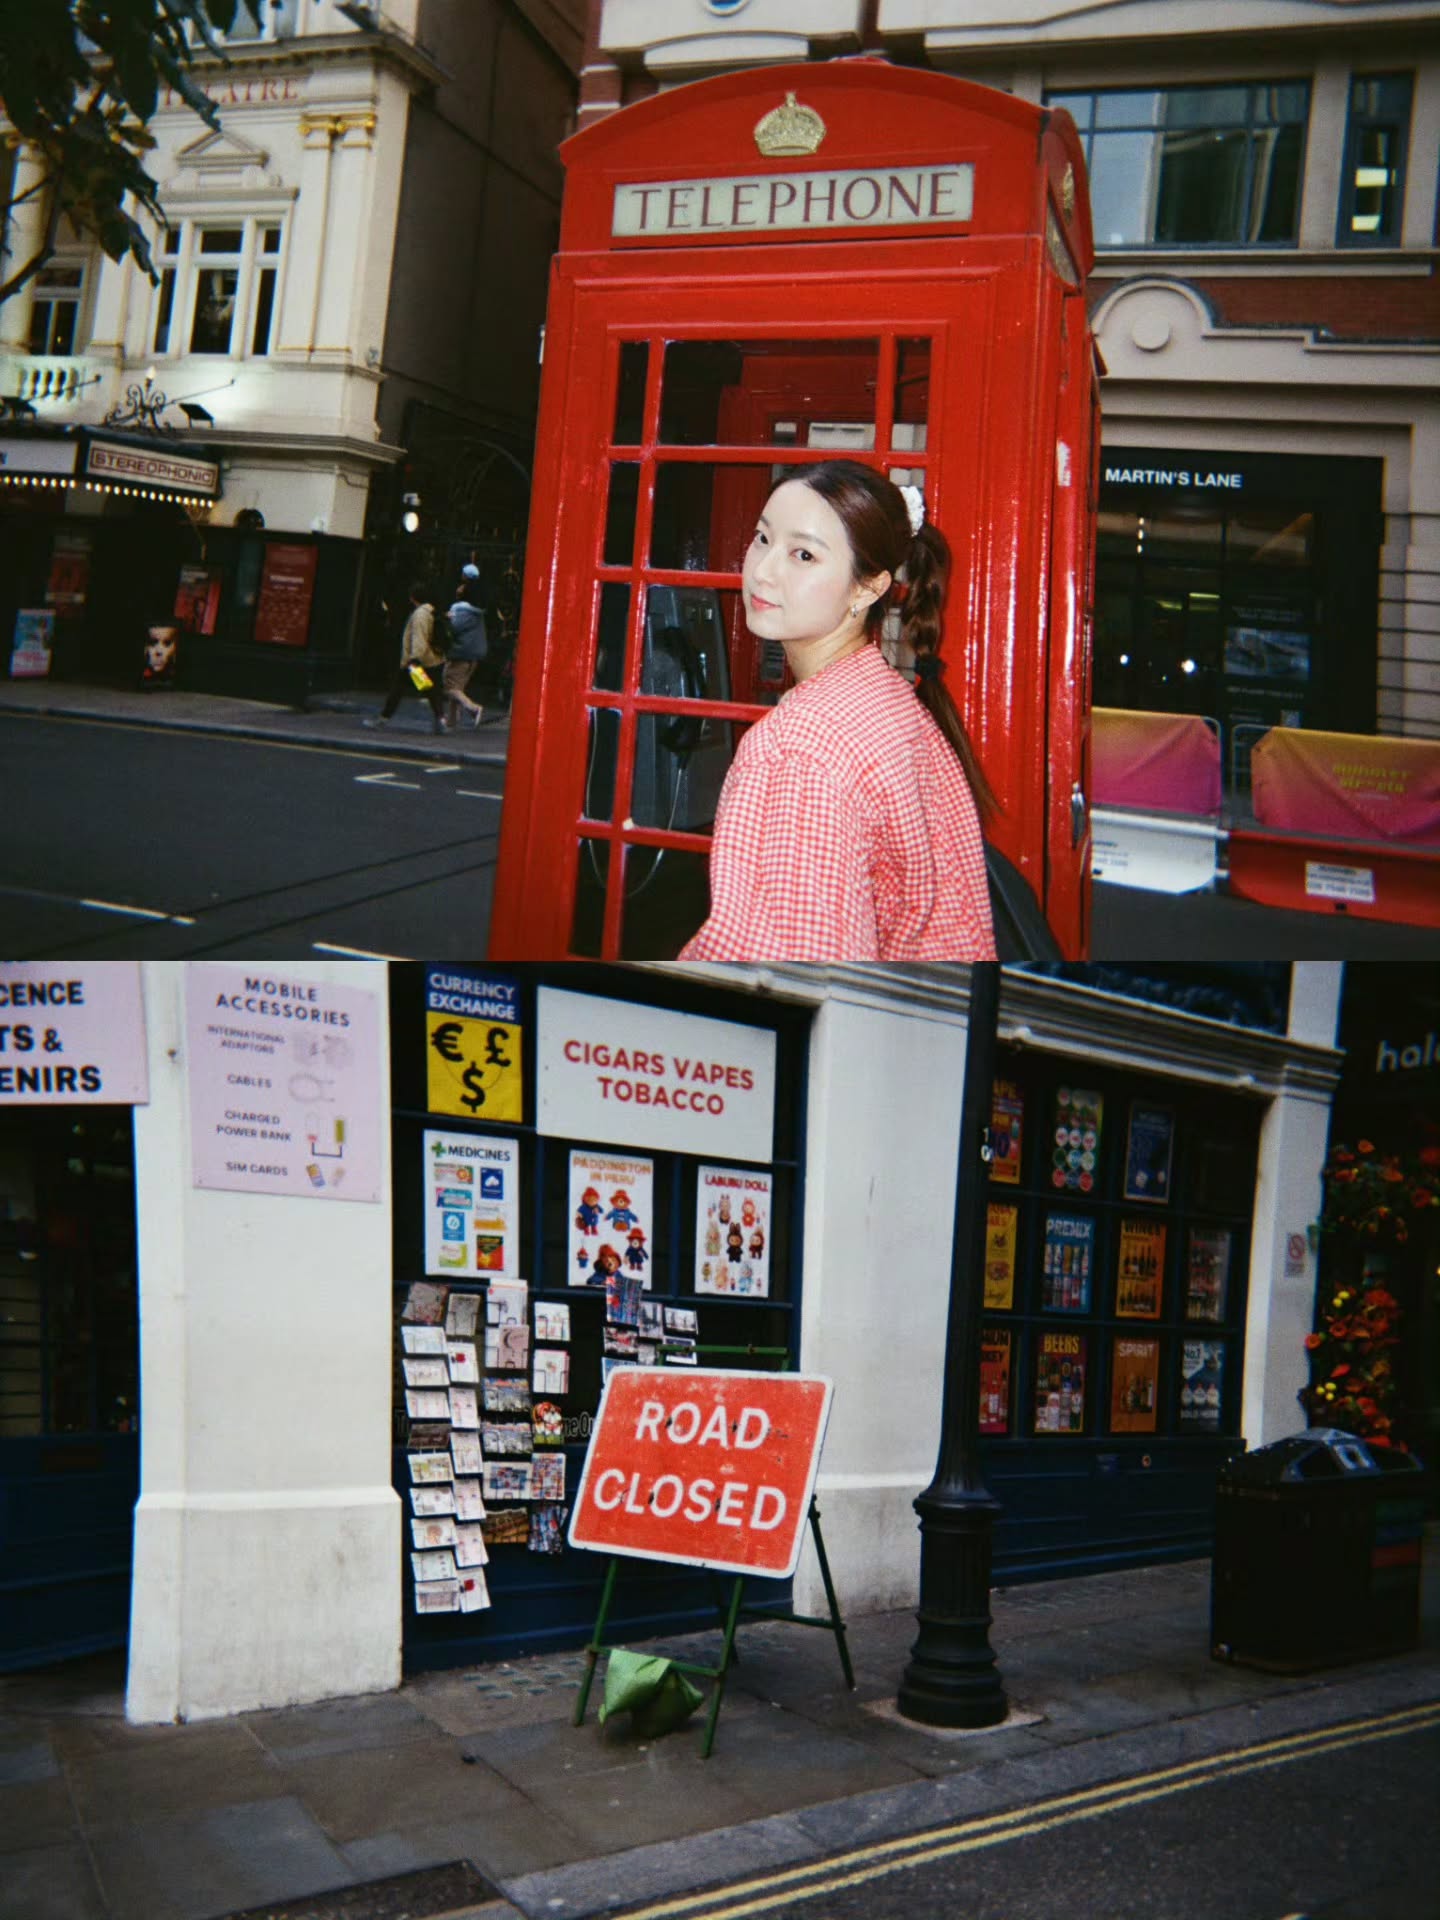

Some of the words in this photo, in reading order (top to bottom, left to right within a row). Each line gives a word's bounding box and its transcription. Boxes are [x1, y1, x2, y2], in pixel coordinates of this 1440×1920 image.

[631, 171, 959, 231] TELEPHONE
[95, 452, 212, 483] STEREOPHONIC
[1105, 468, 1190, 485] MARTIN'S
[1194, 472, 1242, 488] LANE
[245, 977, 316, 1001] MOBILE
[429, 973, 514, 1000] CURRENCY
[215, 994, 350, 1027] ACCESSORIES
[429, 992, 515, 1020] EXCHANGE
[42, 1028, 63, 1053] &
[430, 1022, 464, 1062] €
[485, 1027, 511, 1067] £
[563, 1039, 665, 1076] CIGARS
[673, 1057, 754, 1091] VAPES
[227, 1074, 272, 1088] CABLES
[460, 1061, 486, 1114] $
[597, 1076, 724, 1116] TOBACCO
[224, 1110, 280, 1125] CHARGED
[216, 1124, 257, 1138] POWER
[260, 1129, 292, 1142] BANK
[448, 1144, 511, 1161] MEDICINES
[226, 1161, 247, 1172] SIM
[250, 1164, 288, 1177] CARDS
[744, 1178, 769, 1193] DOLL
[1044, 1333, 1080, 1354] BEERS
[635, 1401, 771, 1450] ROAD
[593, 1468, 786, 1530] CLOSED
